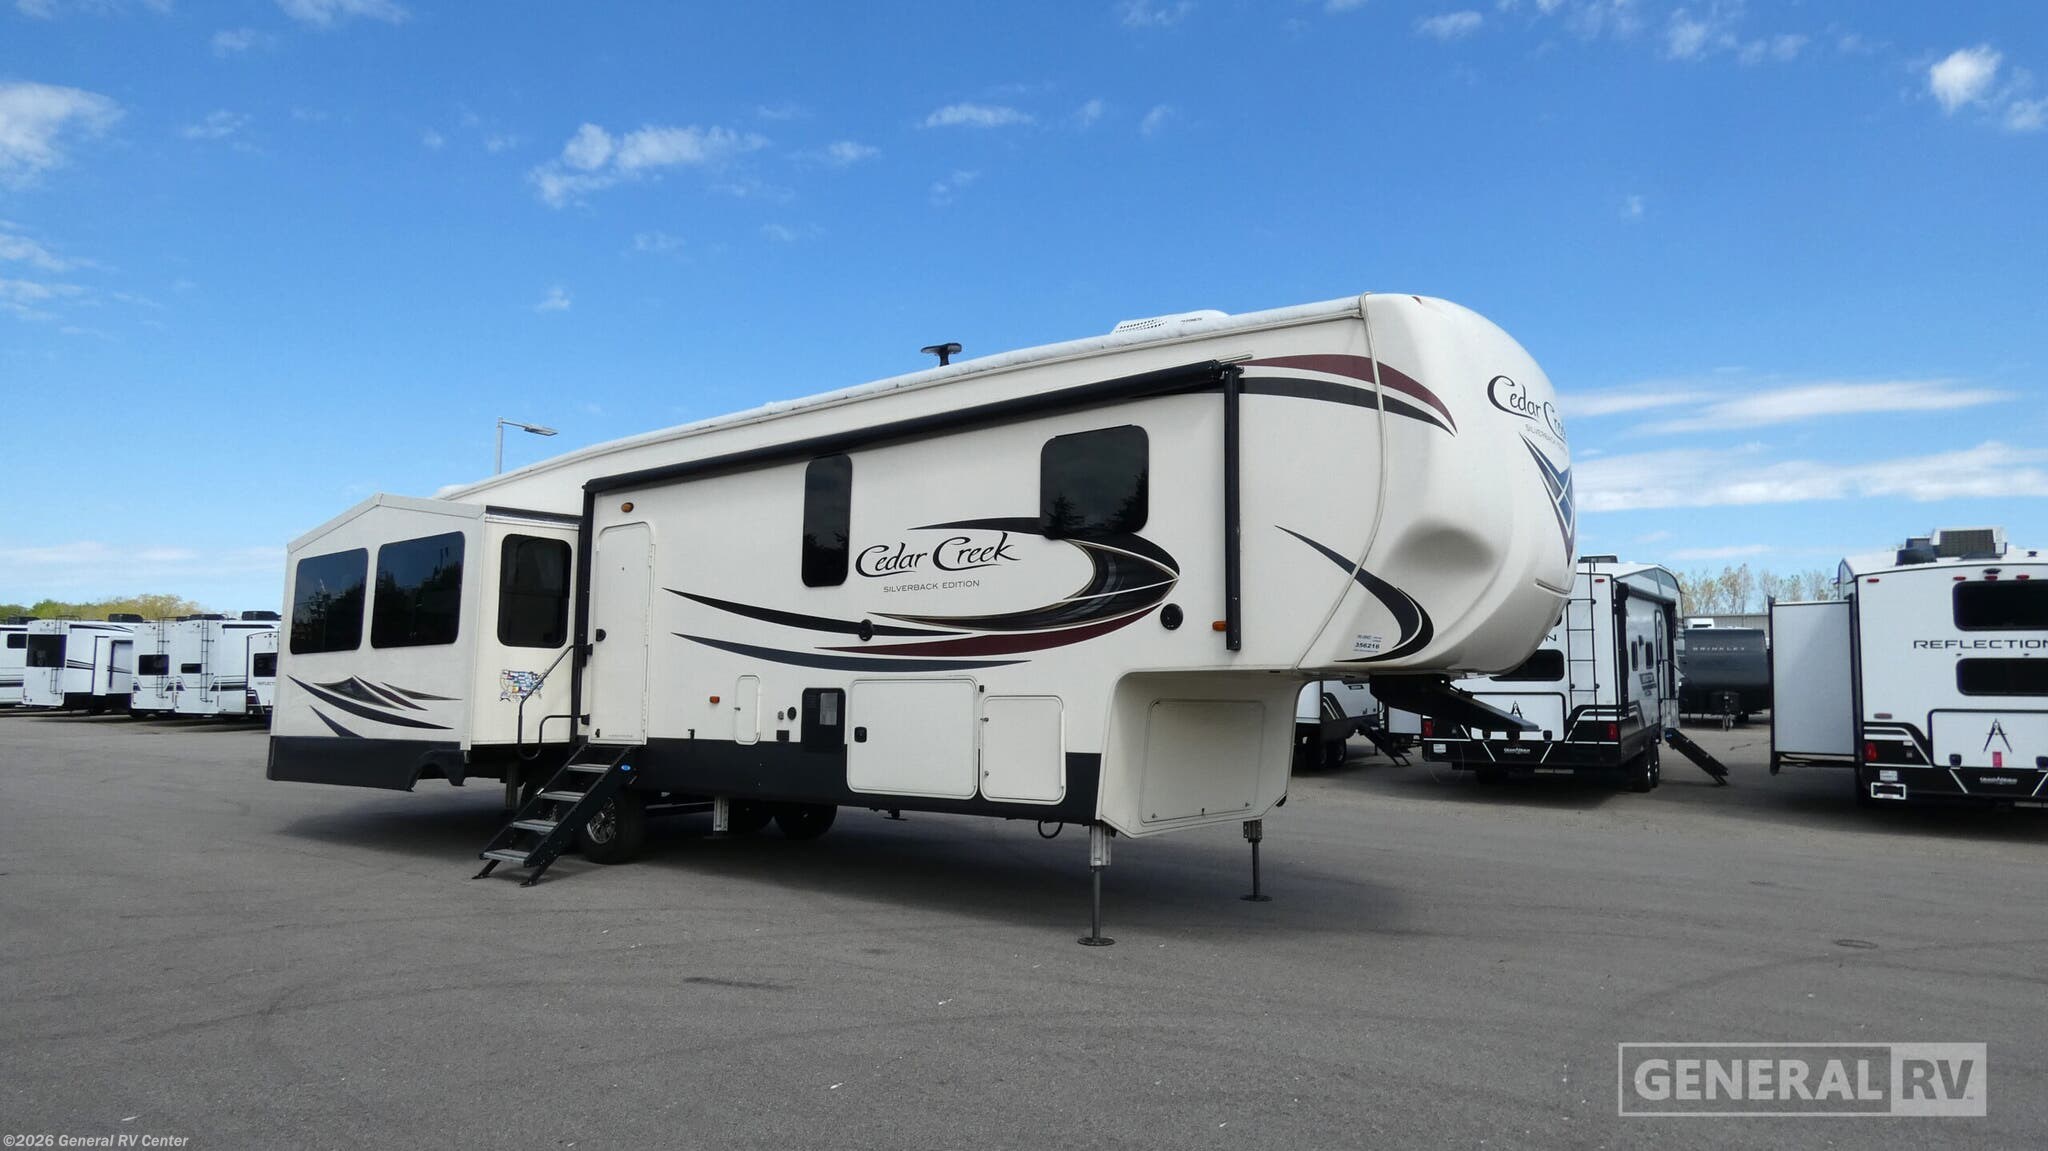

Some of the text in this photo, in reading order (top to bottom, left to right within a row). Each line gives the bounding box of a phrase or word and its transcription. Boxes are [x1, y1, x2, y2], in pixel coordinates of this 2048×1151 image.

[1487, 375, 1542, 423] Cedar
[855, 531, 1022, 578] Cedar Creek
[883, 580, 980, 593] SILVERBACK EDITION
